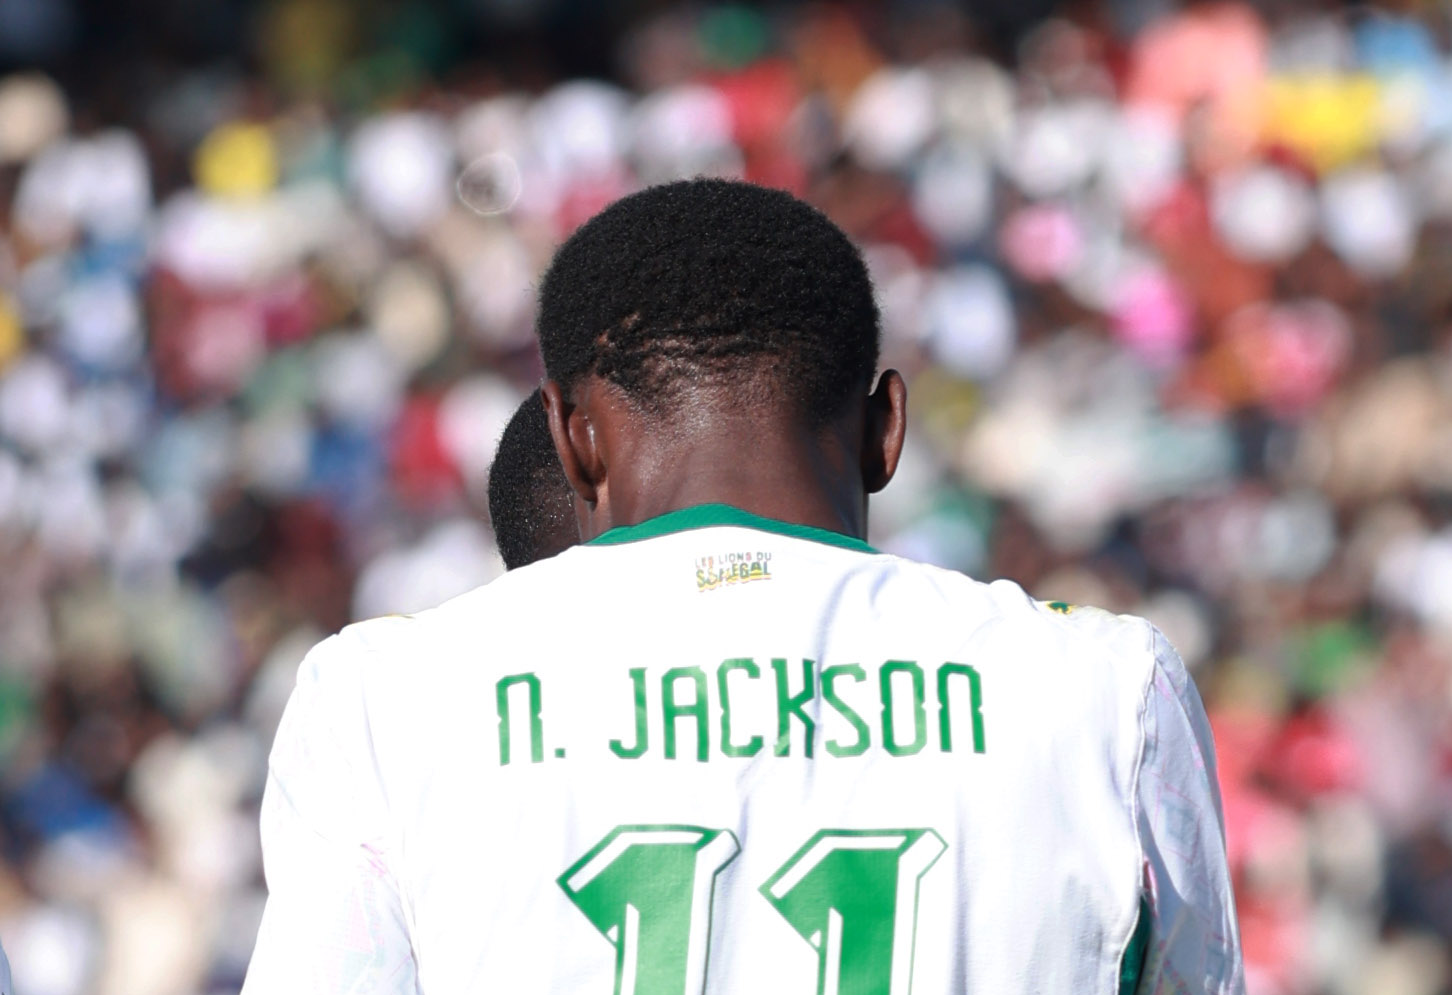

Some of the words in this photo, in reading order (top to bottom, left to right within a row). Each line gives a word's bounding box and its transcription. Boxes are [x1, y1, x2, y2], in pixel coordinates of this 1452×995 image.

[718, 551, 752, 564] LIONS
[756, 551, 772, 561] DU
[495, 671, 566, 766] N.
[609, 658, 987, 763] JACKSON
